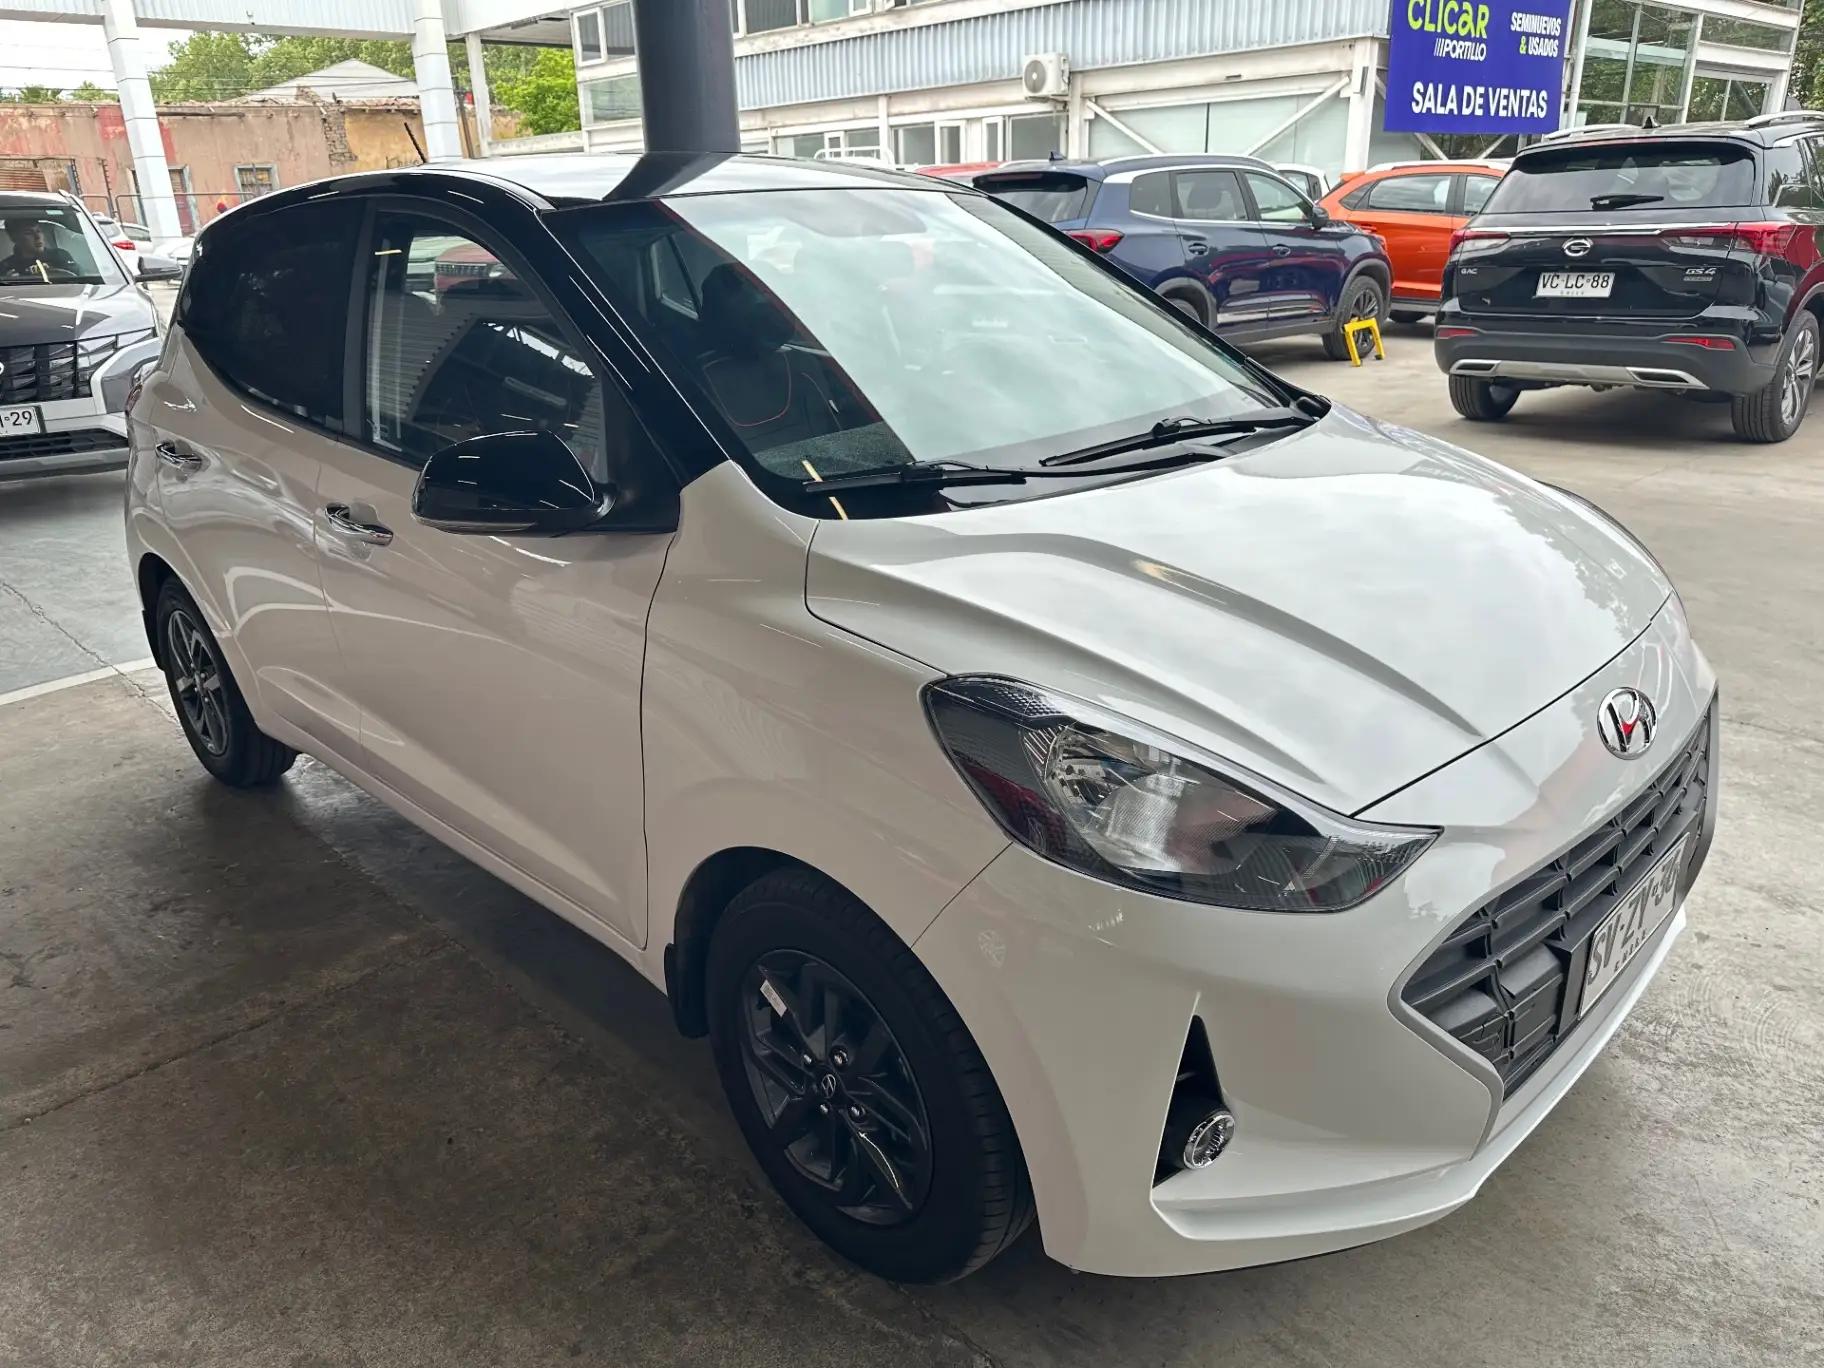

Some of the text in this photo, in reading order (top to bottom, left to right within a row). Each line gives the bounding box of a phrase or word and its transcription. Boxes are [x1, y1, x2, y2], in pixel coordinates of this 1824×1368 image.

[1510, 12, 1561, 36] SEMINUEVOS
[1519, 36, 1559, 58] & USADOS
[1411, 81, 1548, 119] SALA DE VENTAS
